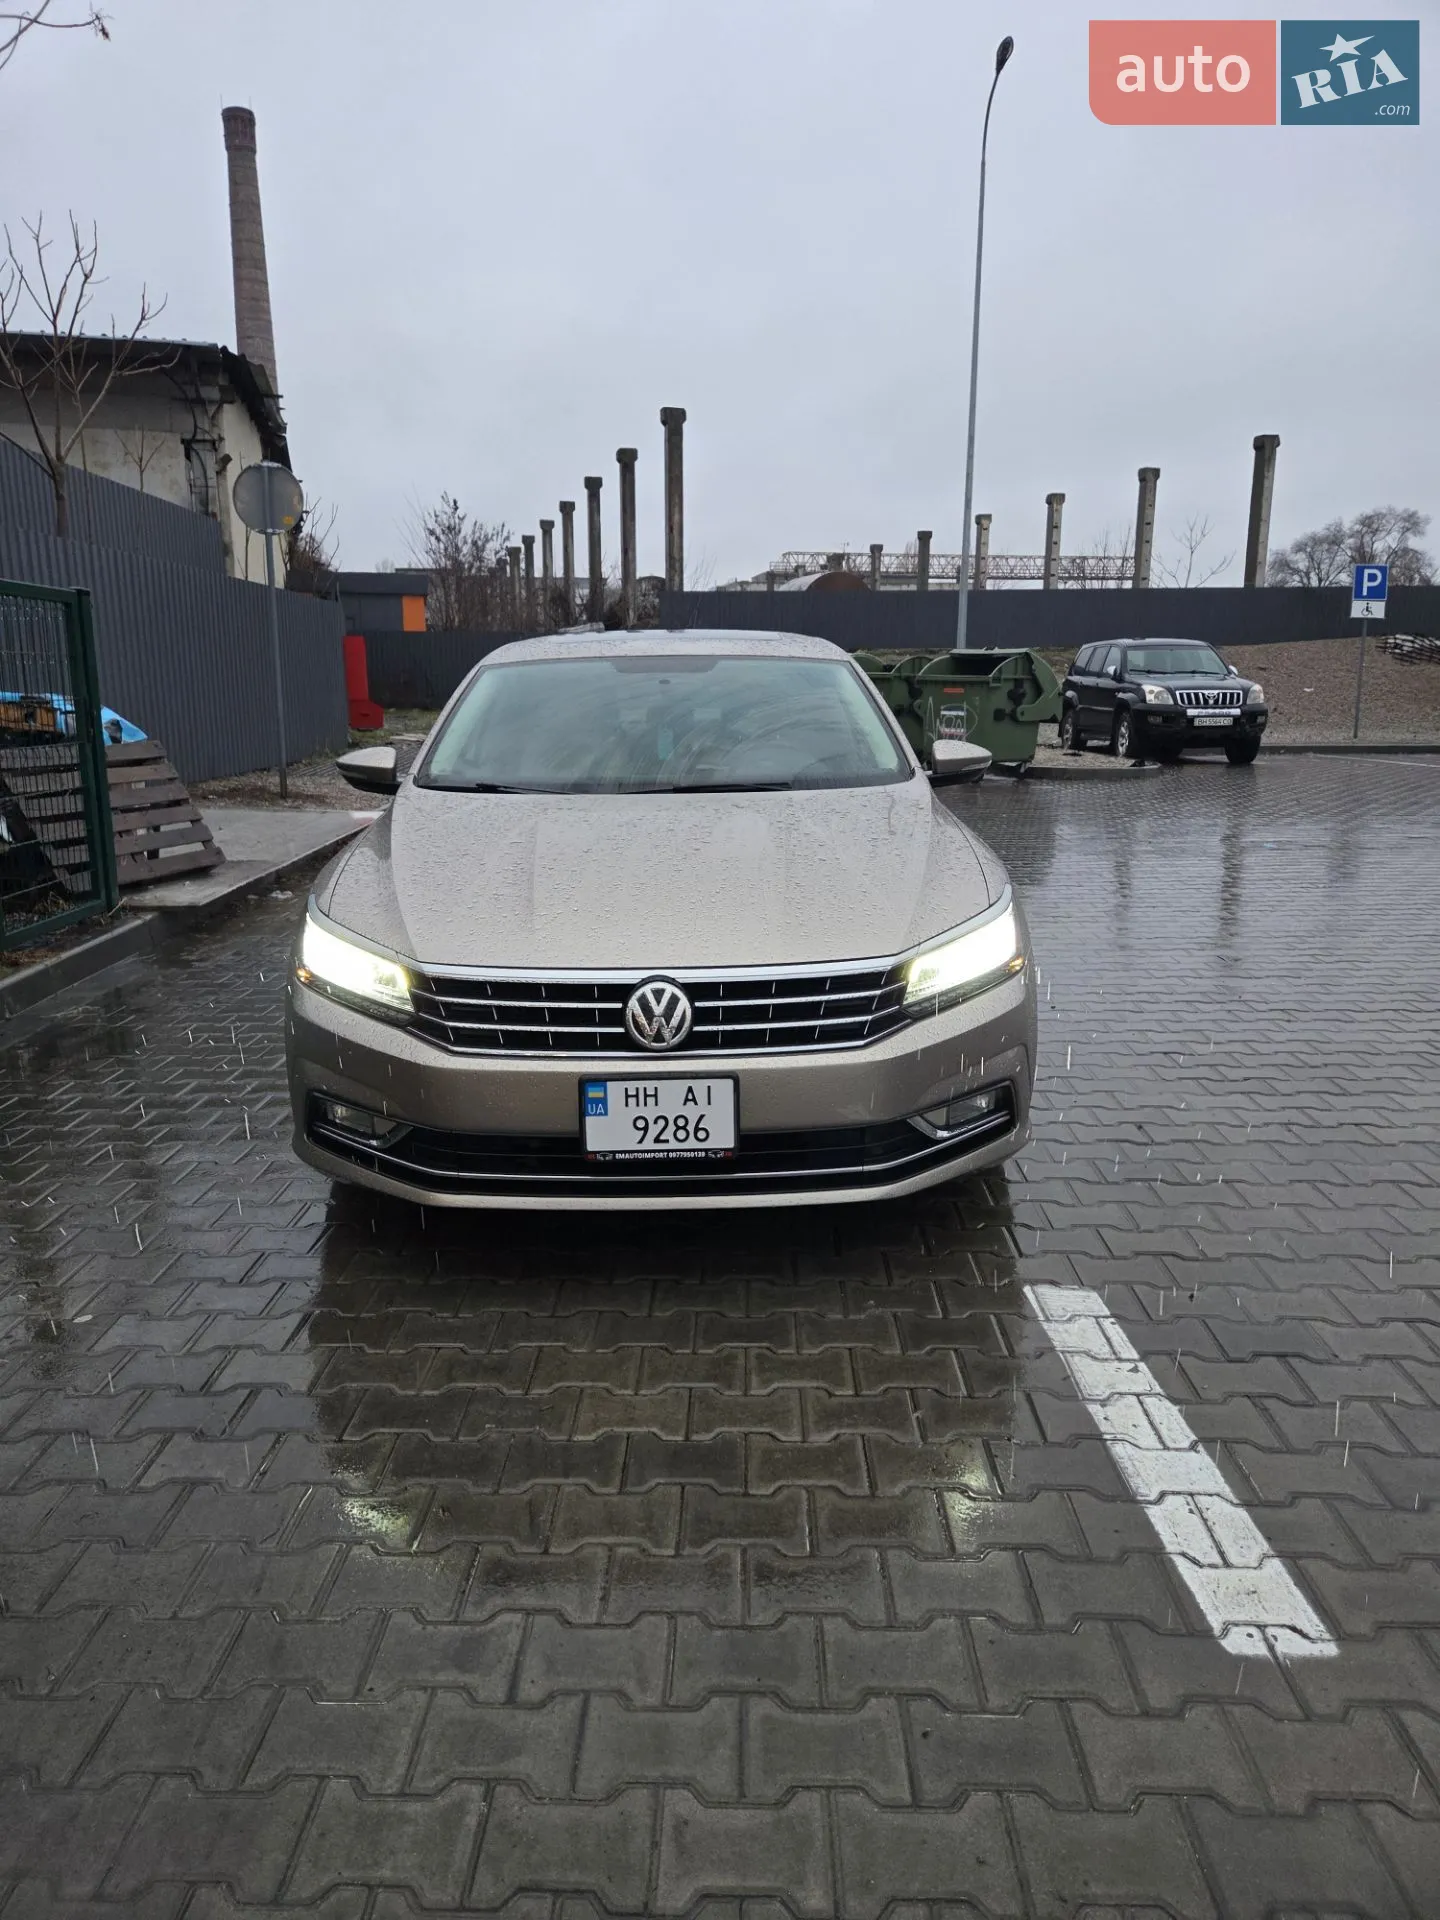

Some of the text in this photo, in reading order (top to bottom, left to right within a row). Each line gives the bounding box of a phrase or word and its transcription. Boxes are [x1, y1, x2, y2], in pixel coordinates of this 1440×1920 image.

[1362, 568, 1382, 596] P
[588, 1103, 605, 1115] UA
[624, 1085, 712, 1108] HH AI
[632, 1114, 710, 1144] 9286
